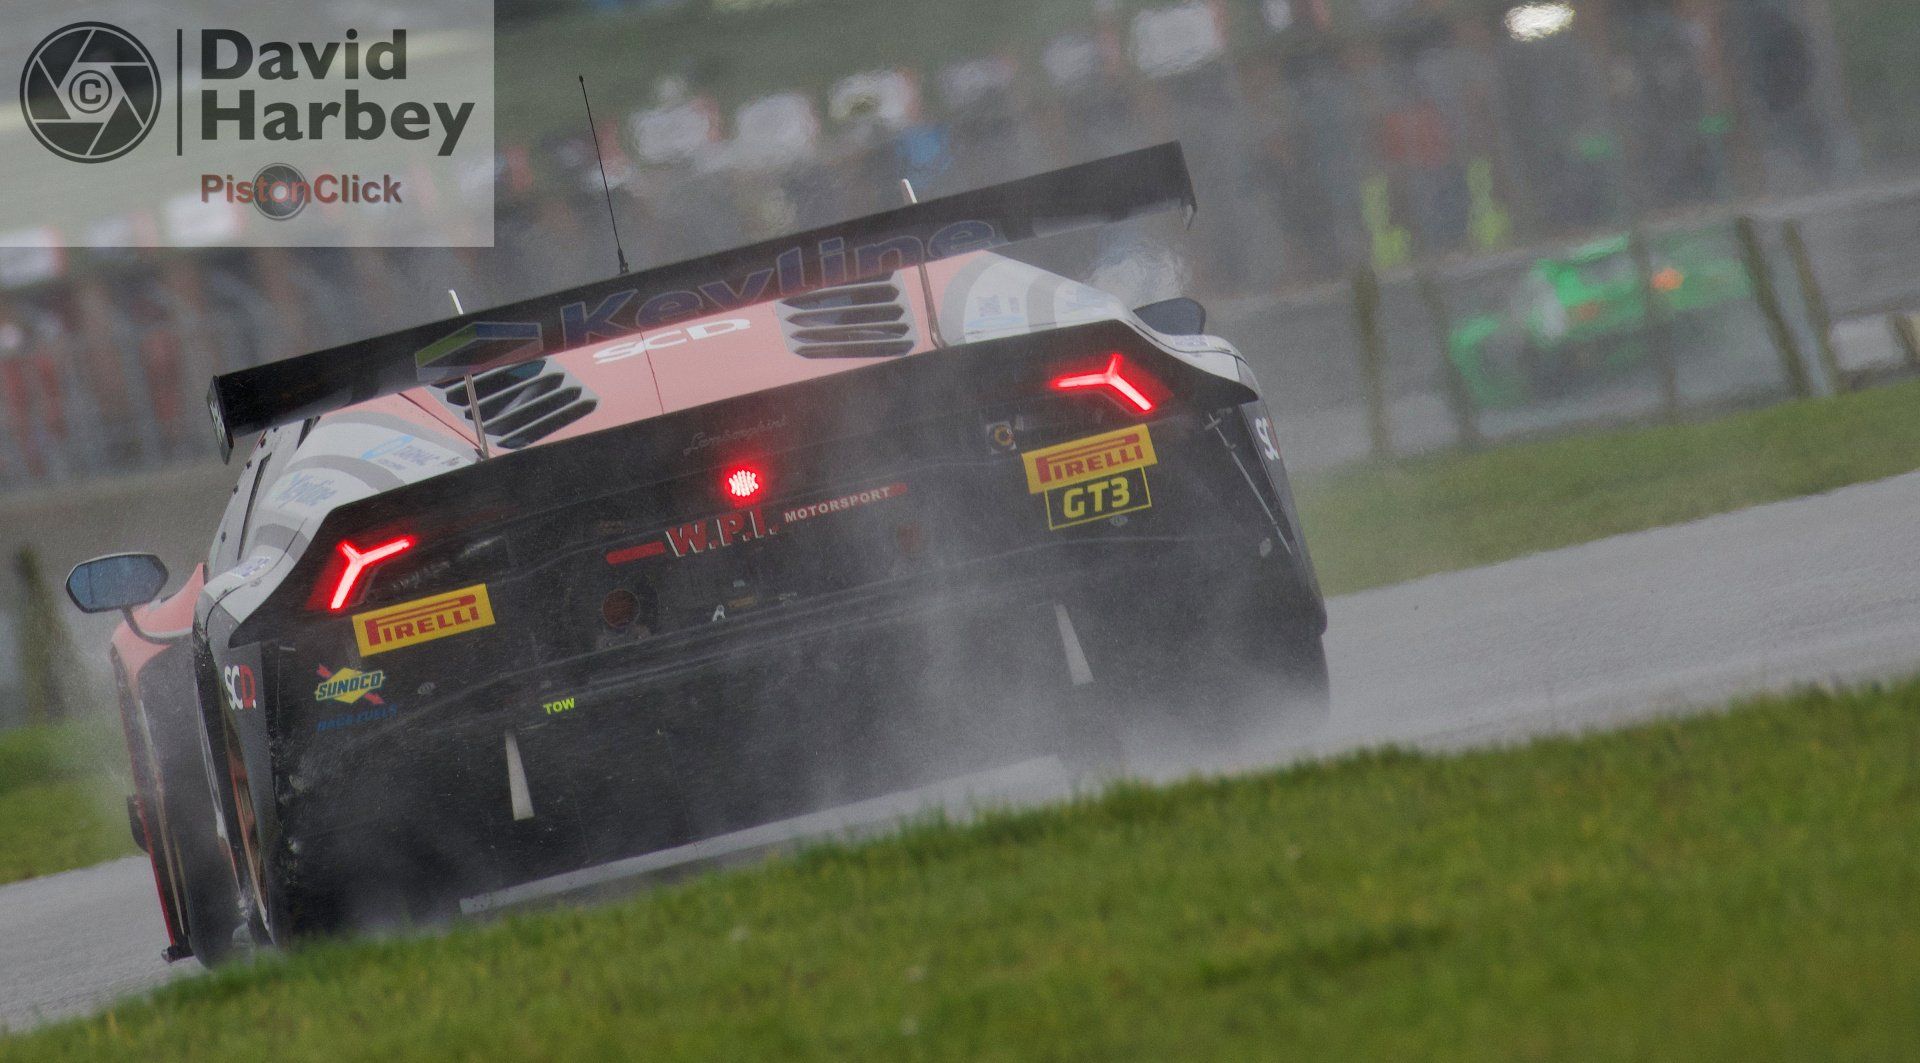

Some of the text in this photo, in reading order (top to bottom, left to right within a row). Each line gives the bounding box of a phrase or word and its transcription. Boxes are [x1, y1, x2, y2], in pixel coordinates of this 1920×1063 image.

[593, 317, 751, 365] SCD
[1035, 433, 1145, 484] PIRELLI
[1063, 476, 1130, 519] GT3
[665, 486, 892, 558] W.P.I. MOTORSPORT
[364, 594, 479, 646] PIRELLI
[317, 671, 382, 700] SUNOCO
[543, 697, 575, 715] TOW
